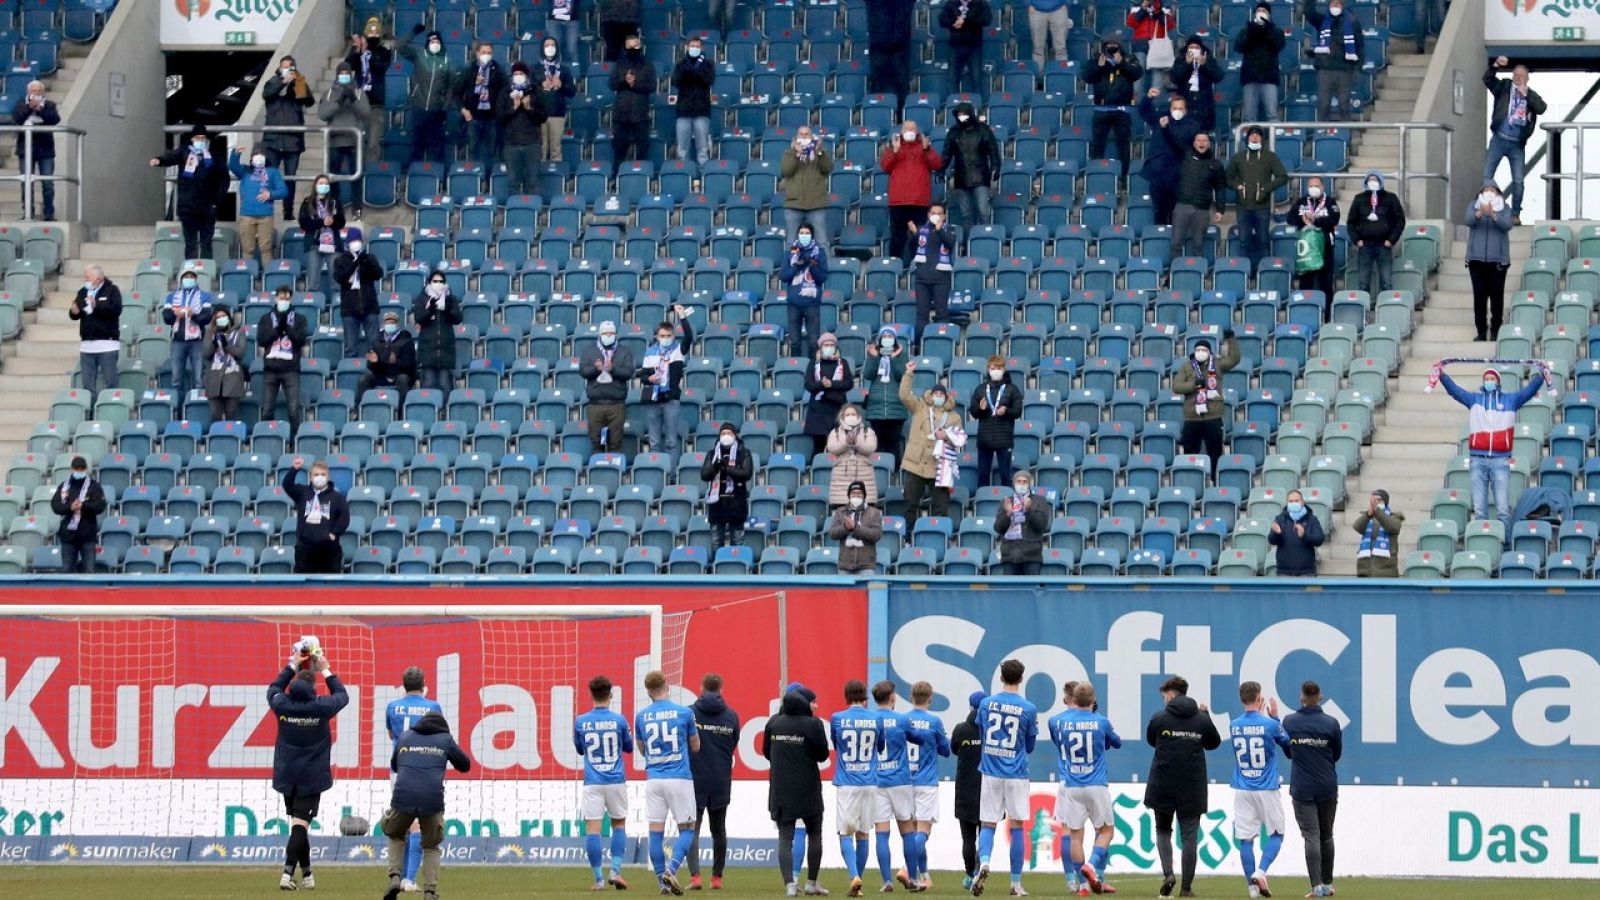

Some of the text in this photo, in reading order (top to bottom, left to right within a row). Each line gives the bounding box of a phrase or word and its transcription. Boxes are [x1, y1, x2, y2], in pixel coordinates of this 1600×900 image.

[656, 710, 678, 720] HANSA
[1001, 704, 1024, 716] HANSA
[594, 720, 618, 730] HANSA
[854, 719, 877, 729] HANSA
[985, 712, 1020, 750] 23
[1075, 720, 1098, 731] HANSA
[1243, 725, 1265, 736] HANSA
[584, 732, 618, 763] 20
[644, 720, 679, 755] 24
[841, 729, 876, 762] 38
[1068, 731, 1094, 765] 21
[1233, 736, 1266, 769] 26
[1448, 811, 1599, 864] Das L
[82, 843, 181, 858] sunmaker
